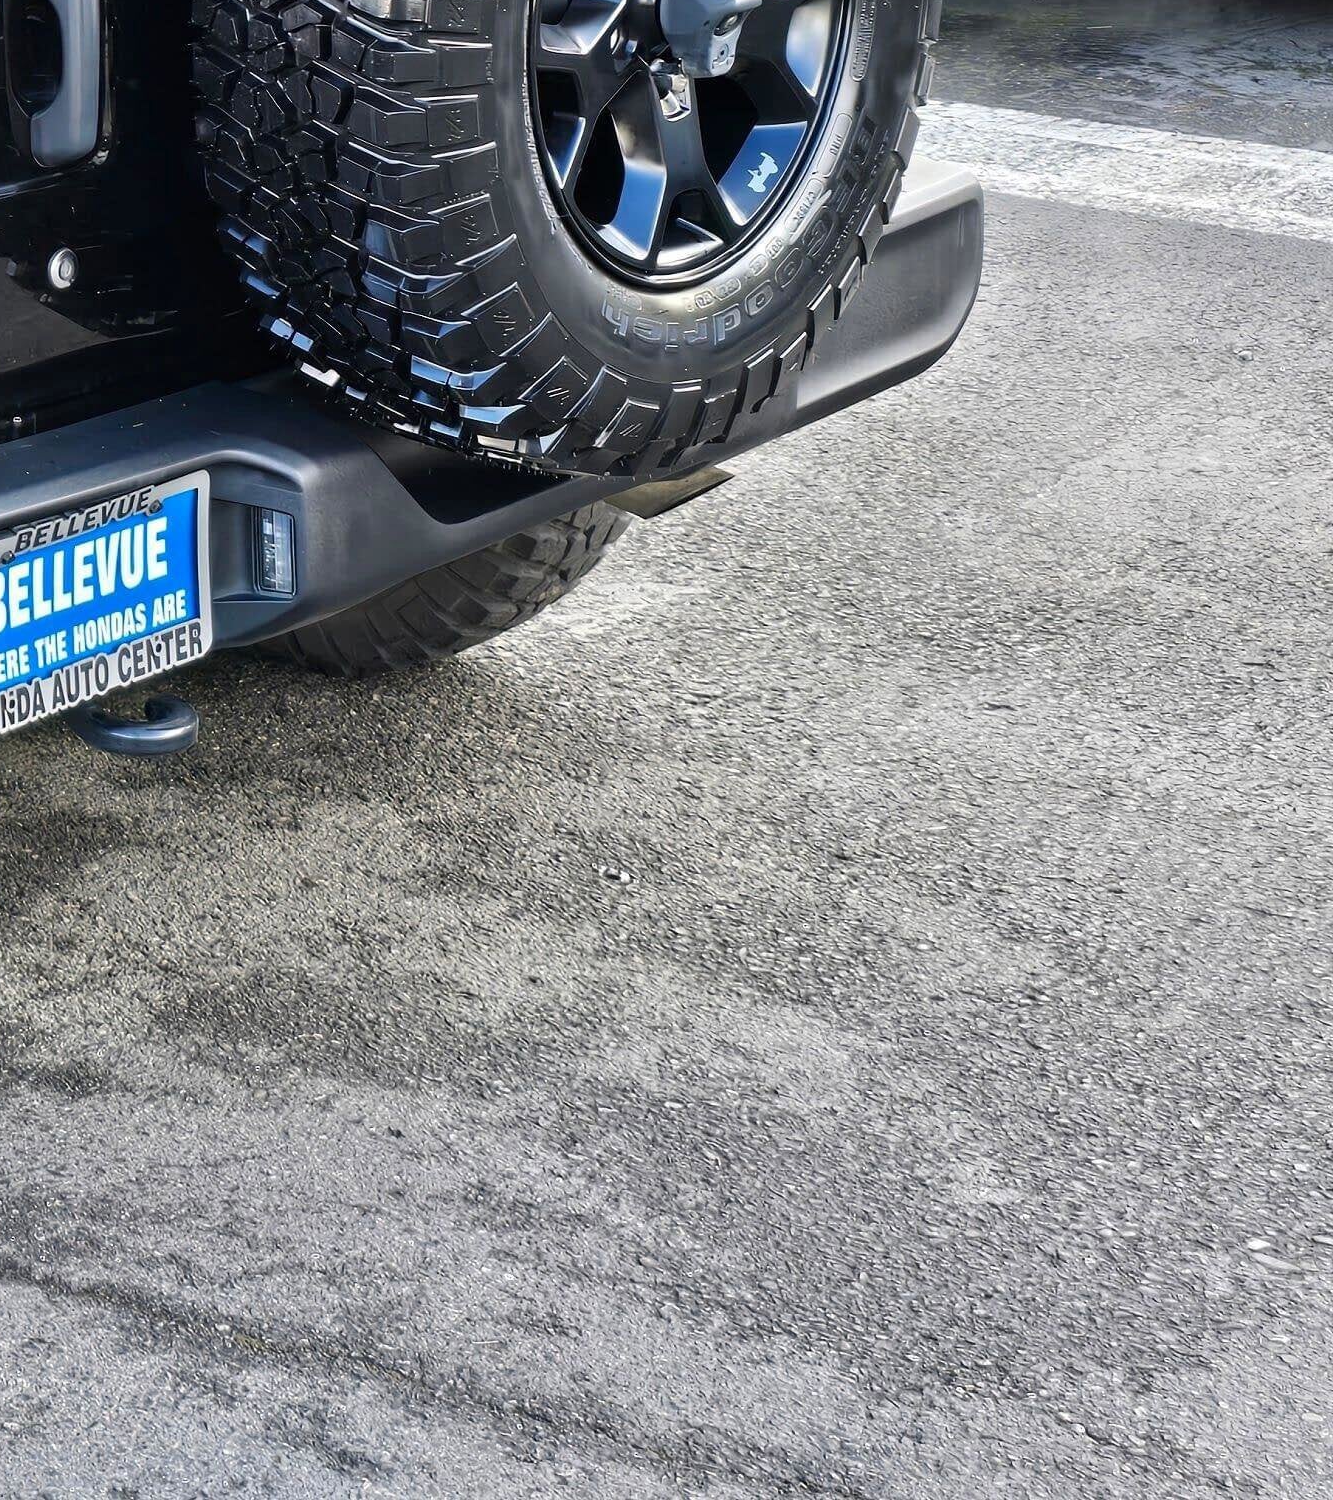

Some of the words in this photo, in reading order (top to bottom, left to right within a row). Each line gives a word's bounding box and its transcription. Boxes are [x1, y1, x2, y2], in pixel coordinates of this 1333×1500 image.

[14, 487, 152, 553] BELLEVUE
[34, 630, 67, 669] THE
[73, 603, 147, 654] HONDAS
[152, 589, 187, 628] ARE
[52, 655, 110, 710] AUTO
[117, 622, 203, 683] CENTER
